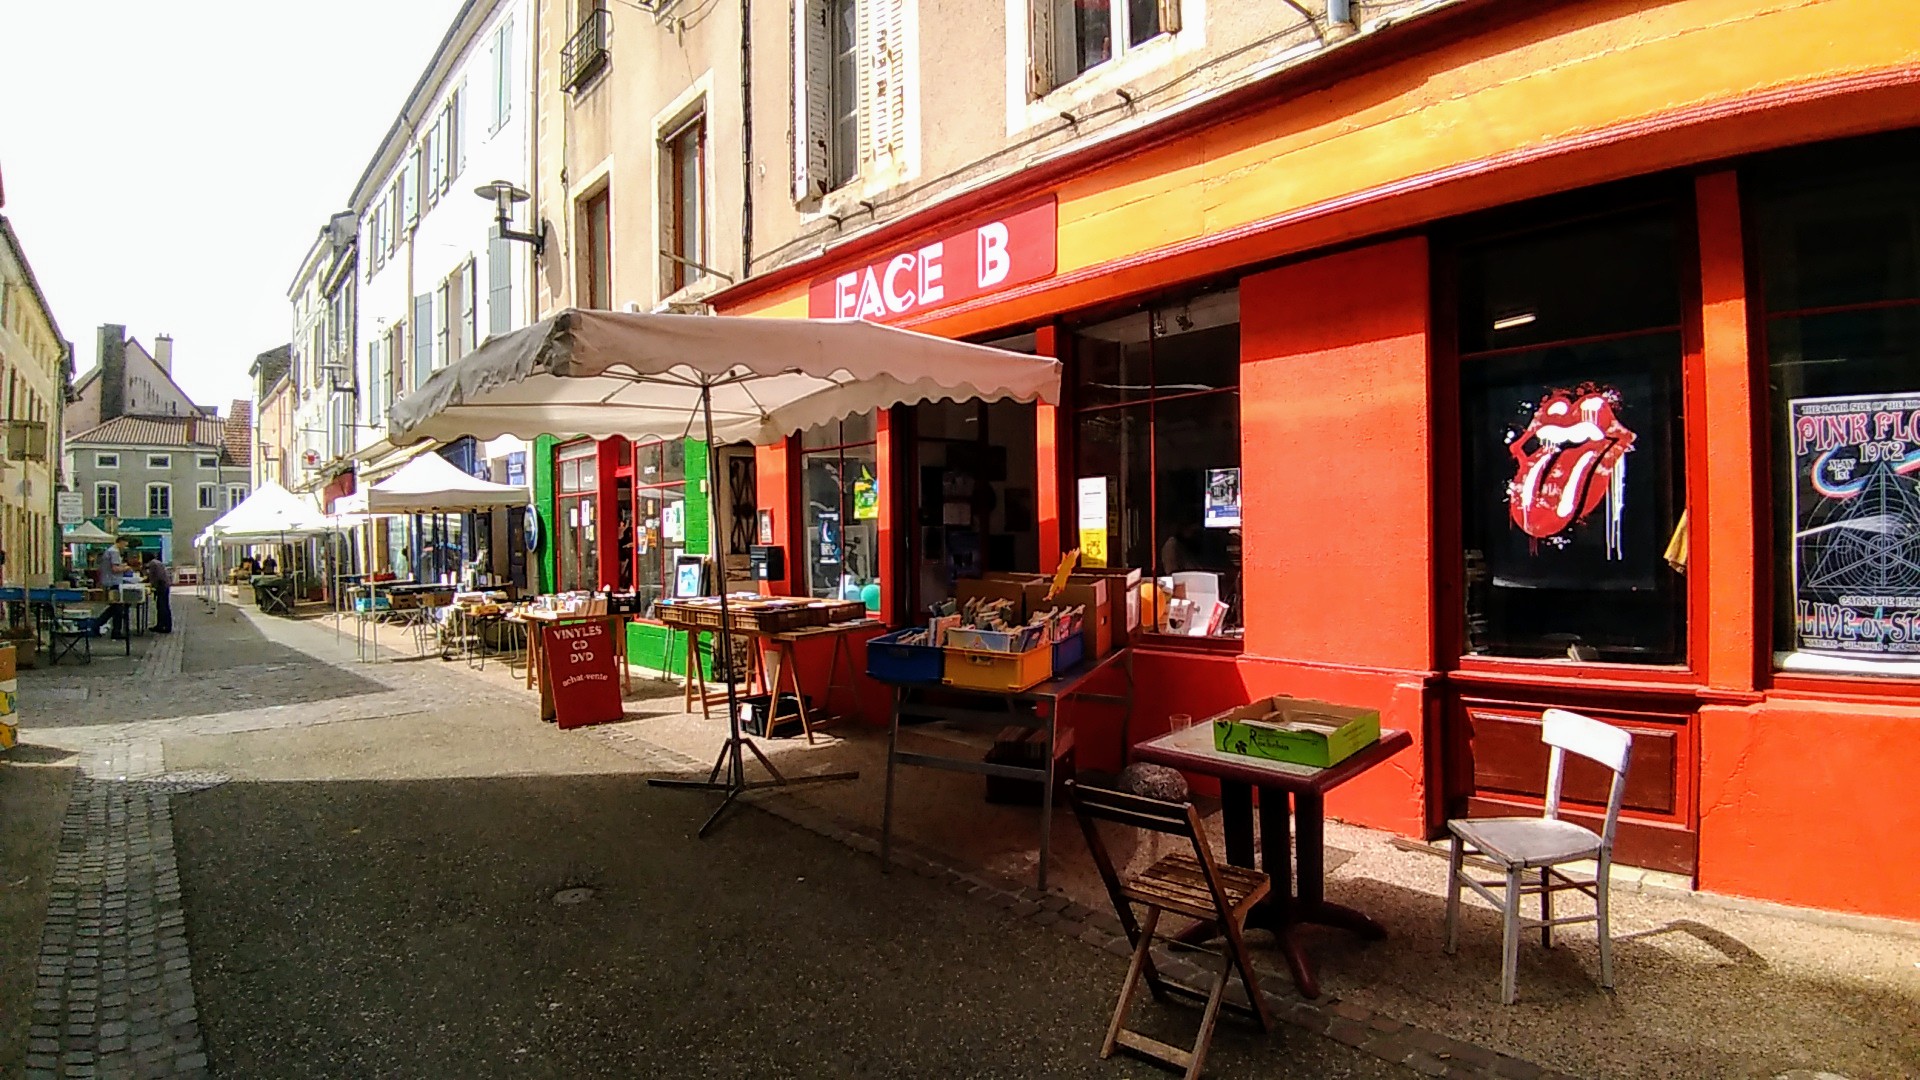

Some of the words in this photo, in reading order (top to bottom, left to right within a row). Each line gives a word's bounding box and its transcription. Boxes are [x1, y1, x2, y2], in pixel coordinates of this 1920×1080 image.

[835, 241, 944, 320] FACE
[977, 221, 1011, 289] B
[1797, 413, 1869, 455] PINK
[1859, 441, 1905, 463] 1972
[1827, 458, 1857, 471] MAY
[1839, 596, 1895, 606] CARNEGIE
[1799, 600, 1857, 640] LIVE
[1861, 618, 1885, 640] ON
[553, 625, 602, 640] VINYLES
[572, 640, 588, 650] CD
[570, 651, 594, 664] DVD
[562, 673, 608, 687] achat-vente
